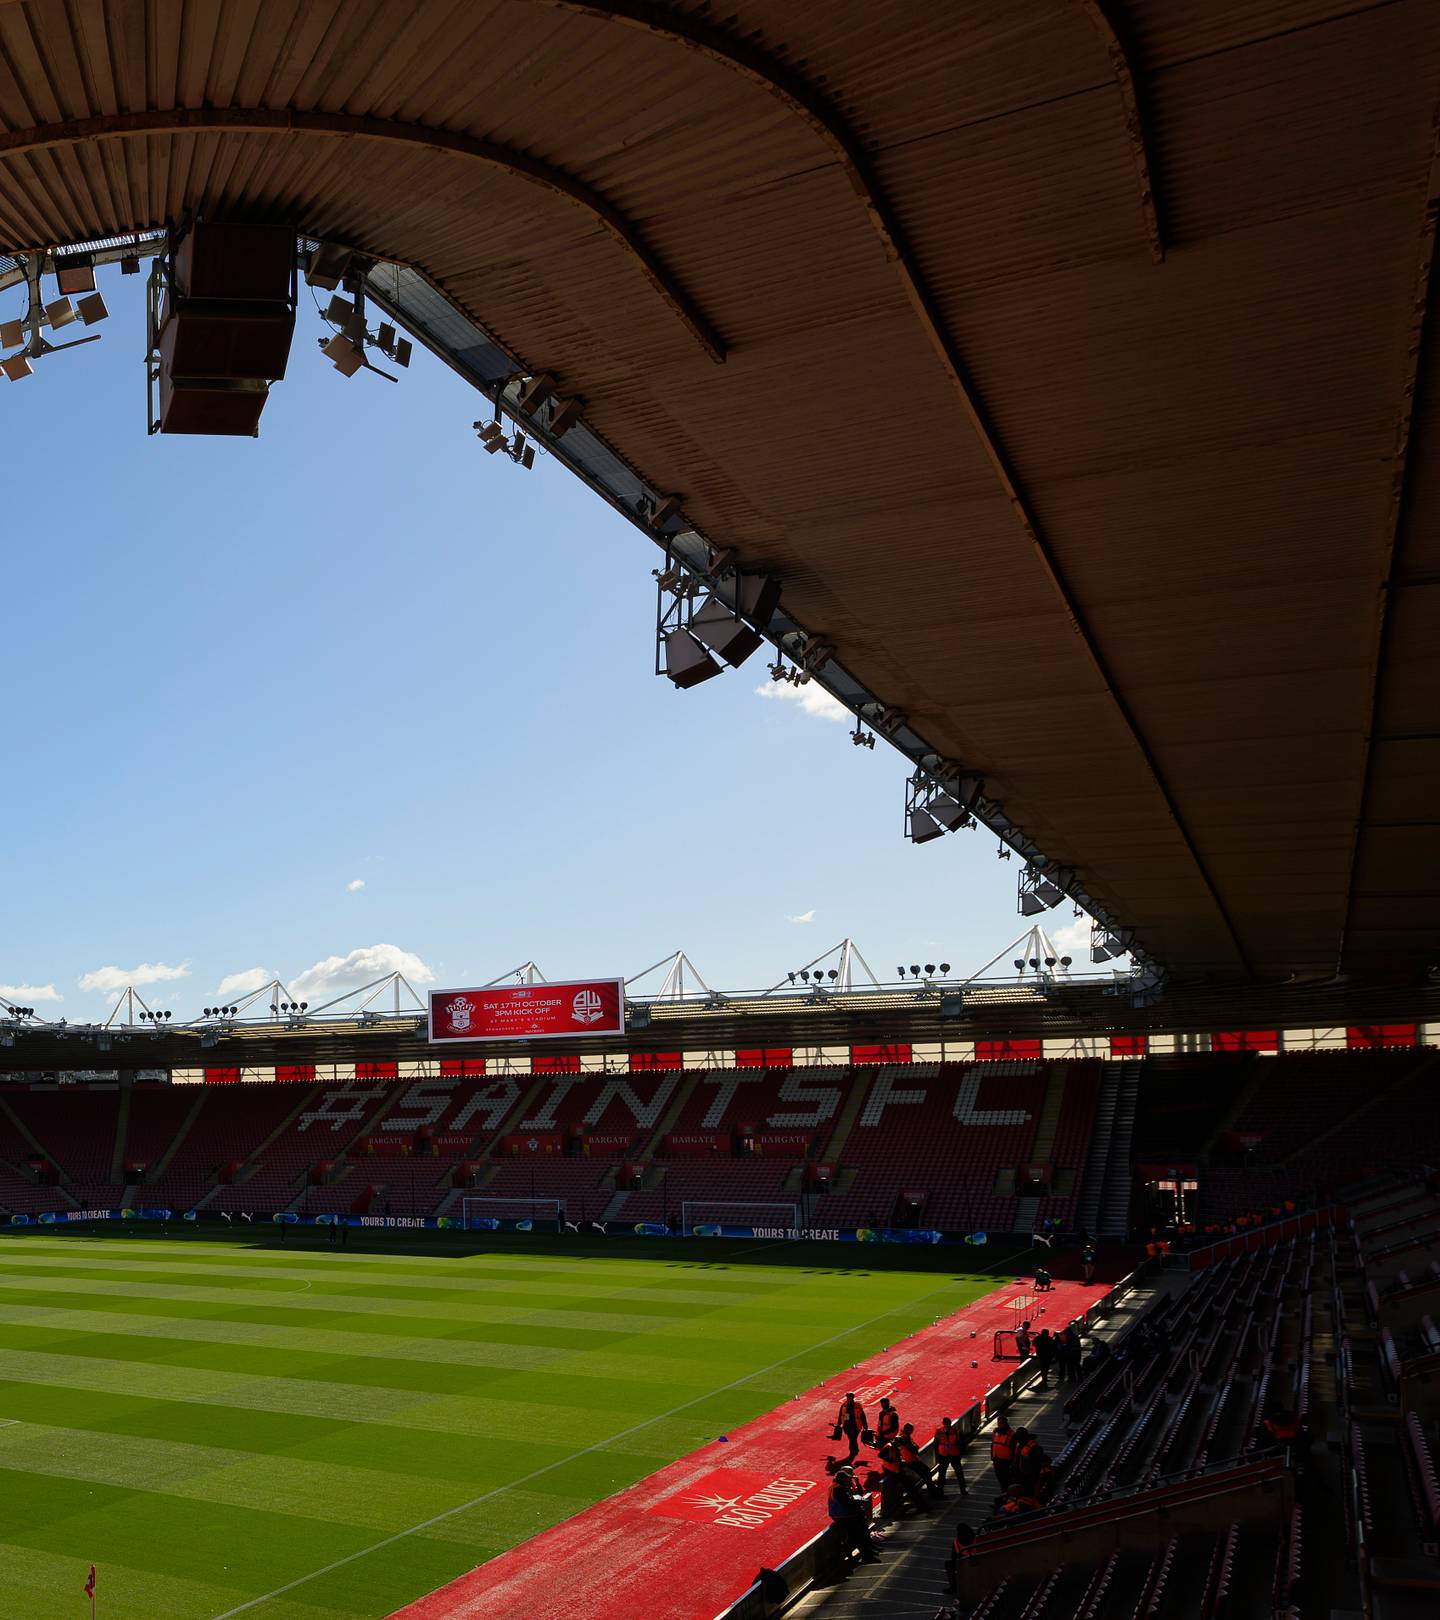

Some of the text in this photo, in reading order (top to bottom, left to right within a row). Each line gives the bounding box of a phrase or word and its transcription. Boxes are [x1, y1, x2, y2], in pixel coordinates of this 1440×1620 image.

[499, 1001, 521, 1009] 17TH
[522, 999, 562, 1008] OCTOBER
[495, 1007, 551, 1017] 3PM KICK OFF
[368, 1137, 402, 1145] BARGATE
[438, 1137, 474, 1145] BARGATE
[588, 1135, 630, 1144] BARGATE
[672, 1135, 716, 1144] BARGATE
[761, 1135, 807, 1144] BARGATE
[360, 1216, 425, 1228] YOURS TO CREATE
[752, 1227, 839, 1241] YOURS TO CREATE
[713, 1477, 817, 1531] P&O CRUISES
